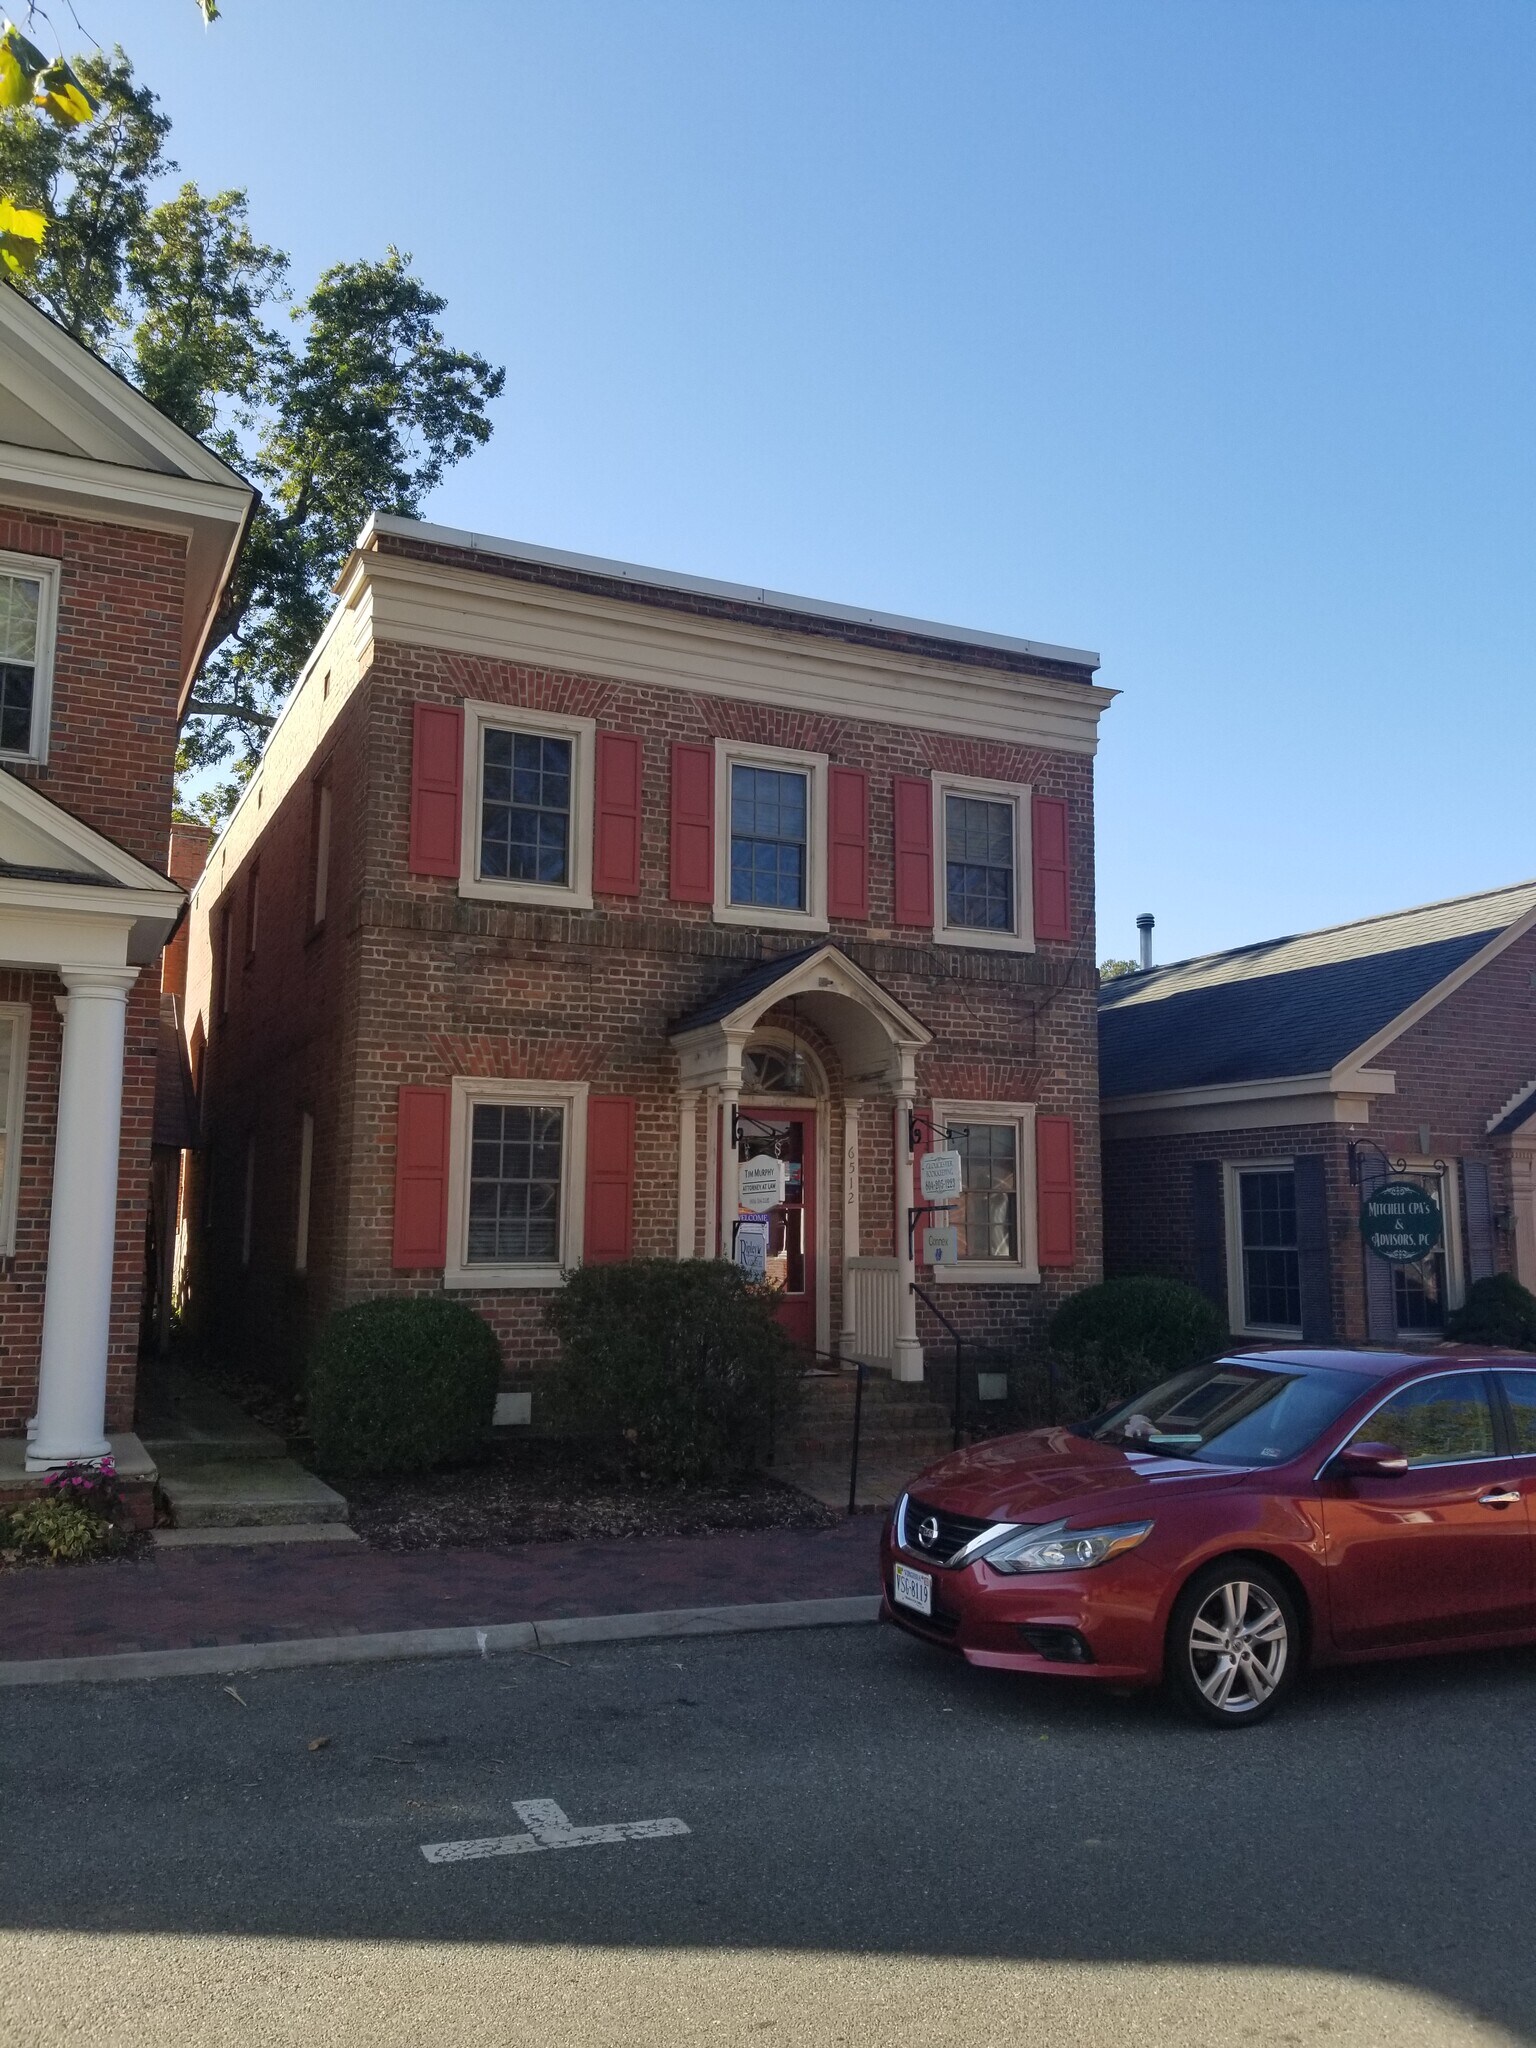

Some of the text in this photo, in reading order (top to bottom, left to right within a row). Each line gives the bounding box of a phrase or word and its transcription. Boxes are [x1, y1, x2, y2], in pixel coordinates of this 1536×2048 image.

[754, 1168, 775, 1178] MURPHY
[1368, 1201, 1430, 1217] MITCHELL CPA's
[1394, 1218, 1405, 1230] &
[1371, 1232, 1430, 1247] ADVISORS, PC
